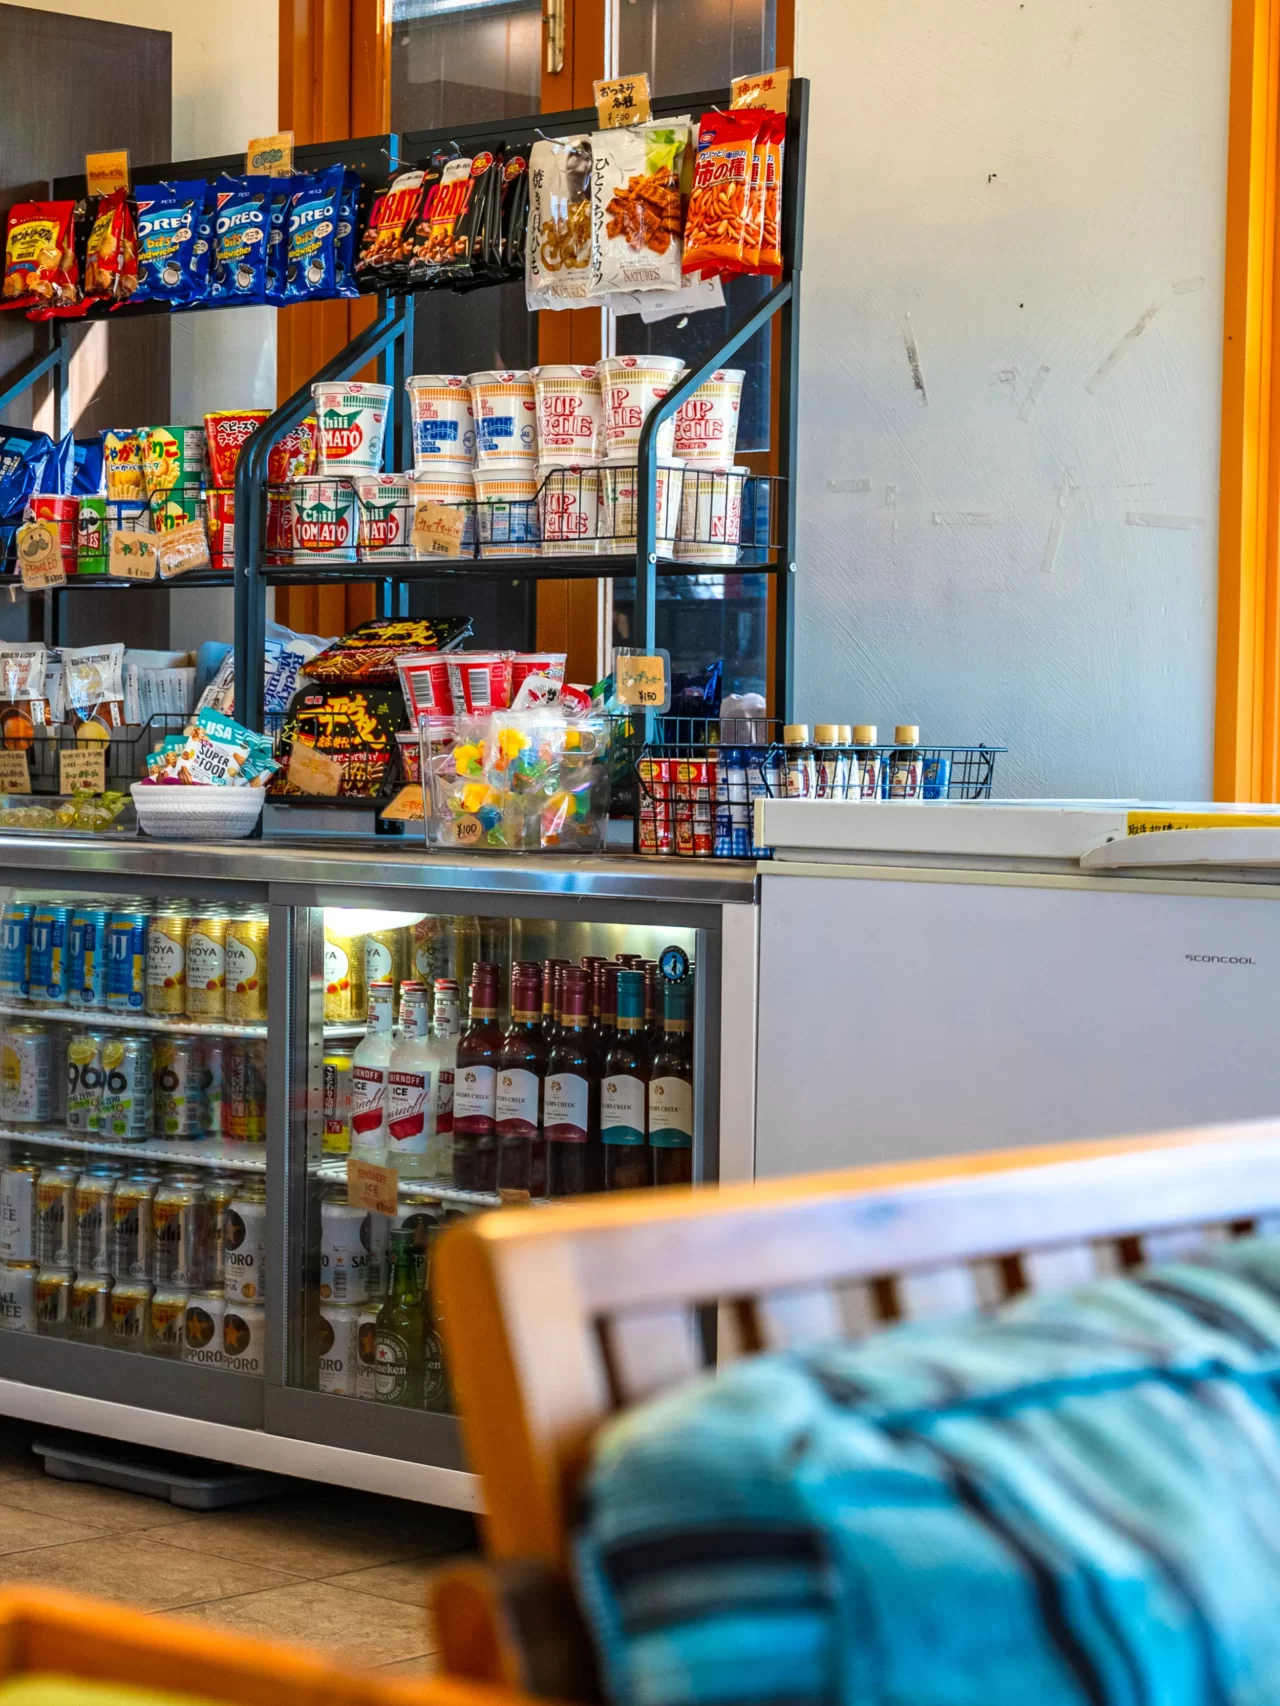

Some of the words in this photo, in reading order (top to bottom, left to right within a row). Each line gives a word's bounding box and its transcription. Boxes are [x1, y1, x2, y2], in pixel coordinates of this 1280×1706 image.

[600, 83, 636, 98] おつまみ
[737, 77, 776, 98] 柿の種
[612, 95, 637, 108] 各種
[694, 157, 747, 188] 柿の種
[422, 176, 476, 221] CRATZ
[138, 213, 192, 237] OREO
[216, 210, 263, 234] OREO
[289, 206, 334, 233] OREO
[531, 168, 545, 276] 焼き貝ひも
[593, 157, 610, 286] ひとくちソースカツ
[10, 227, 54, 246] カントリーマアム
[146, 235, 171, 249] bits
[223, 233, 242, 248] bits
[295, 229, 315, 246] bits
[16, 248, 35, 260] mini
[138, 243, 180, 260] andwiches
[216, 246, 252, 260] andwiches
[288, 241, 323, 258] andwiches
[623, 267, 661, 283] NATURES
[552, 284, 587, 300] NATURES
[303, 509, 337, 523] Chili
[283, 652, 305, 710] Rocky
[638, 690, 657, 702] ¥150
[297, 693, 388, 750] 一平ちゃん
[206, 720, 232, 740] USA
[199, 744, 230, 768] SUPER
[199, 758, 226, 779] FOOD
[457, 823, 477, 837] ¥100
[716, 825, 728, 836] alt
[148, 945, 175, 955] HOYA
[188, 947, 217, 957] HOYA
[353, 1068, 380, 1081] IRNOFF
[354, 1082, 368, 1091] ICE
[392, 1087, 409, 1097] ICE
[472, 1093, 490, 1101] CREEK
[509, 1096, 527, 1104] CREEK
[364, 1182, 379, 1195] ICE
